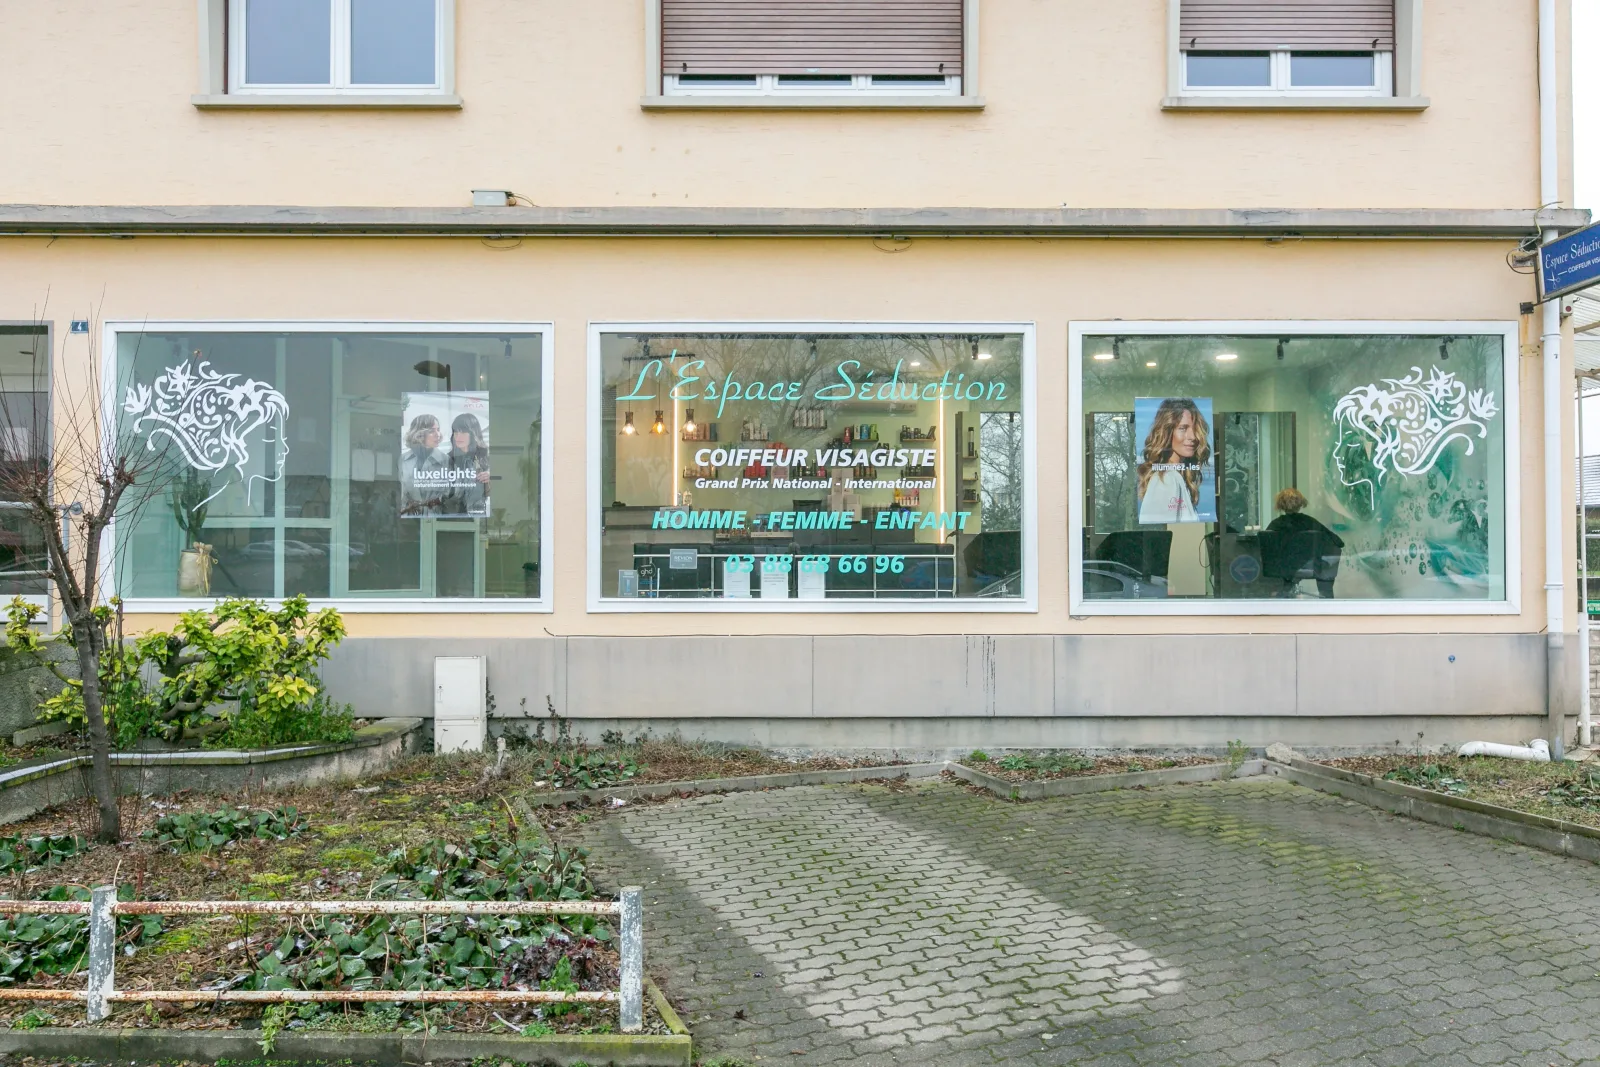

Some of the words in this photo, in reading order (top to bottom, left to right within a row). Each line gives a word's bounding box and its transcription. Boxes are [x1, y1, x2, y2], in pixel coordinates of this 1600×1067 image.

[1545, 254, 1568, 269] Espace
[1568, 259, 1591, 274] COIFFEUR
[616, 348, 802, 418] L'Espace
[814, 358, 1007, 402] Séduction
[694, 448, 808, 467] COIFFEUR
[815, 448, 936, 467] VISAGISTE
[413, 467, 477, 481] luxelights
[695, 477, 738, 489] Grand
[742, 477, 769, 489] Prix
[772, 477, 832, 489] National
[844, 477, 937, 489] International
[652, 510, 746, 530] HOMME
[767, 511, 853, 530] FEMME
[874, 511, 971, 530] ENFANT
[726, 554, 755, 574] 03
[763, 554, 793, 574] 88
[801, 554, 830, 574] 68
[838, 554, 867, 574] 66
[875, 554, 905, 574] 96
[640, 568, 653, 577] ghd
